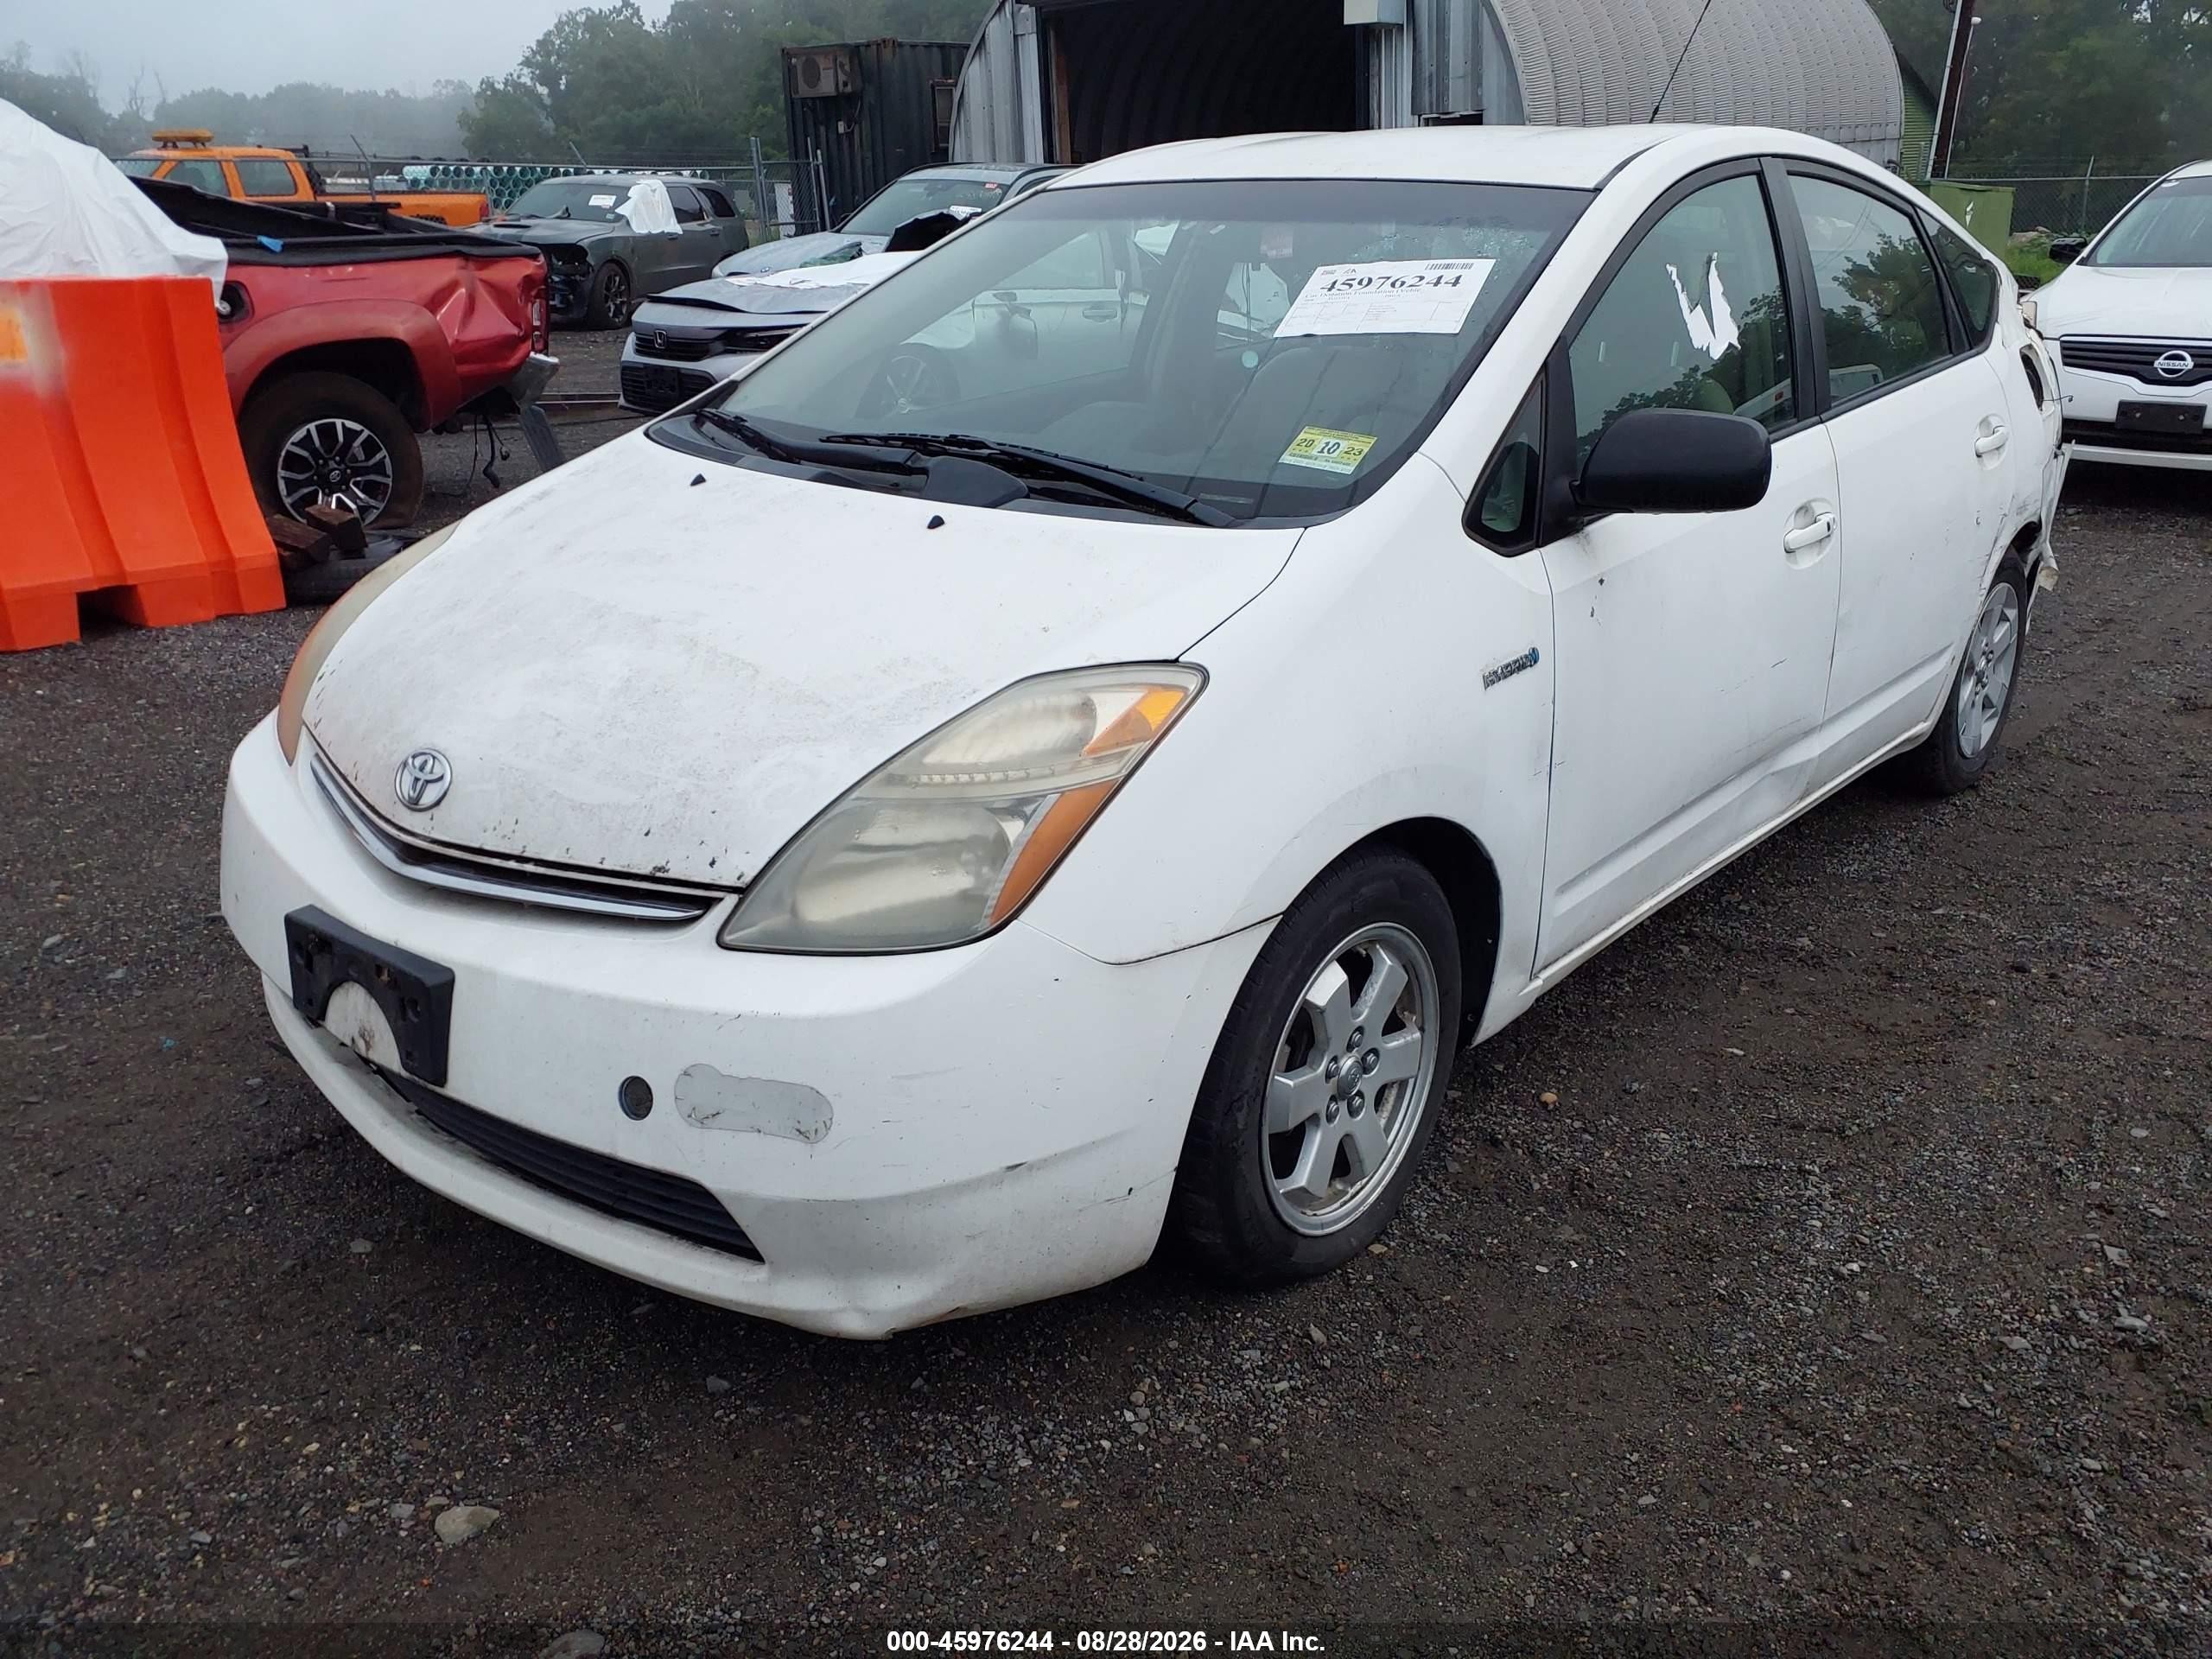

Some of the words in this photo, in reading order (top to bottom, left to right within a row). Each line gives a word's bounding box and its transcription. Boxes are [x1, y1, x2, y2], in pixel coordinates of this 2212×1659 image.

[1319, 274, 1463, 293] 45976244
[1296, 437, 1315, 448] 20
[1317, 441, 1341, 454] 10
[1344, 446, 1363, 456] 23
